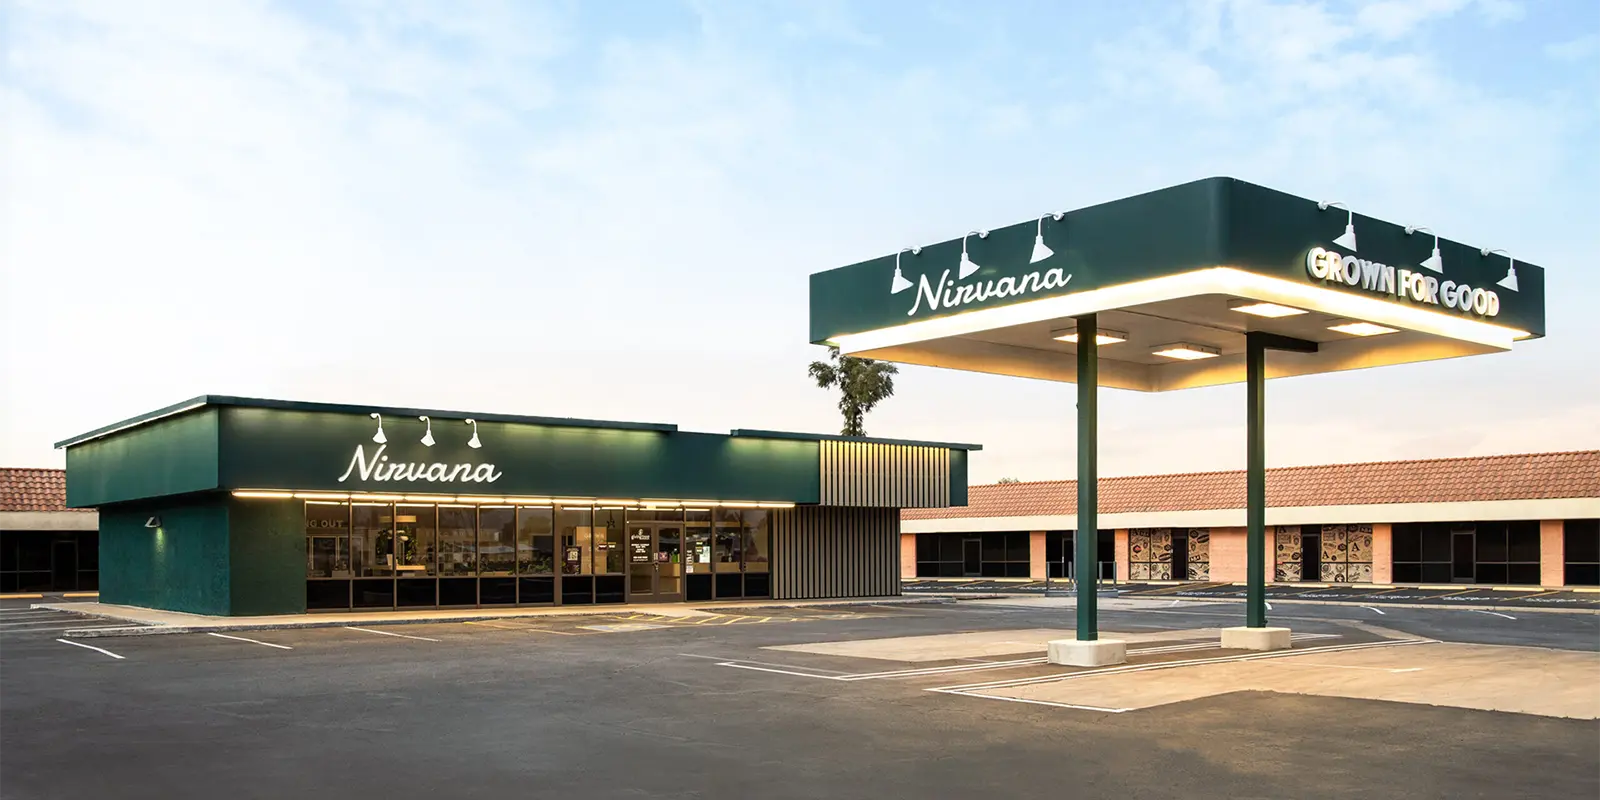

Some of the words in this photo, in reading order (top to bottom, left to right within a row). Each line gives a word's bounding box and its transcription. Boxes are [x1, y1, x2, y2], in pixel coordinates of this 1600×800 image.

[907, 268, 1072, 316] Nirvana
[1307, 247, 1395, 294] GROWN
[1397, 269, 1439, 305] FOR
[1440, 280, 1500, 317] GOOD
[337, 444, 502, 482] Nirvana
[320, 519, 344, 528] OUT
